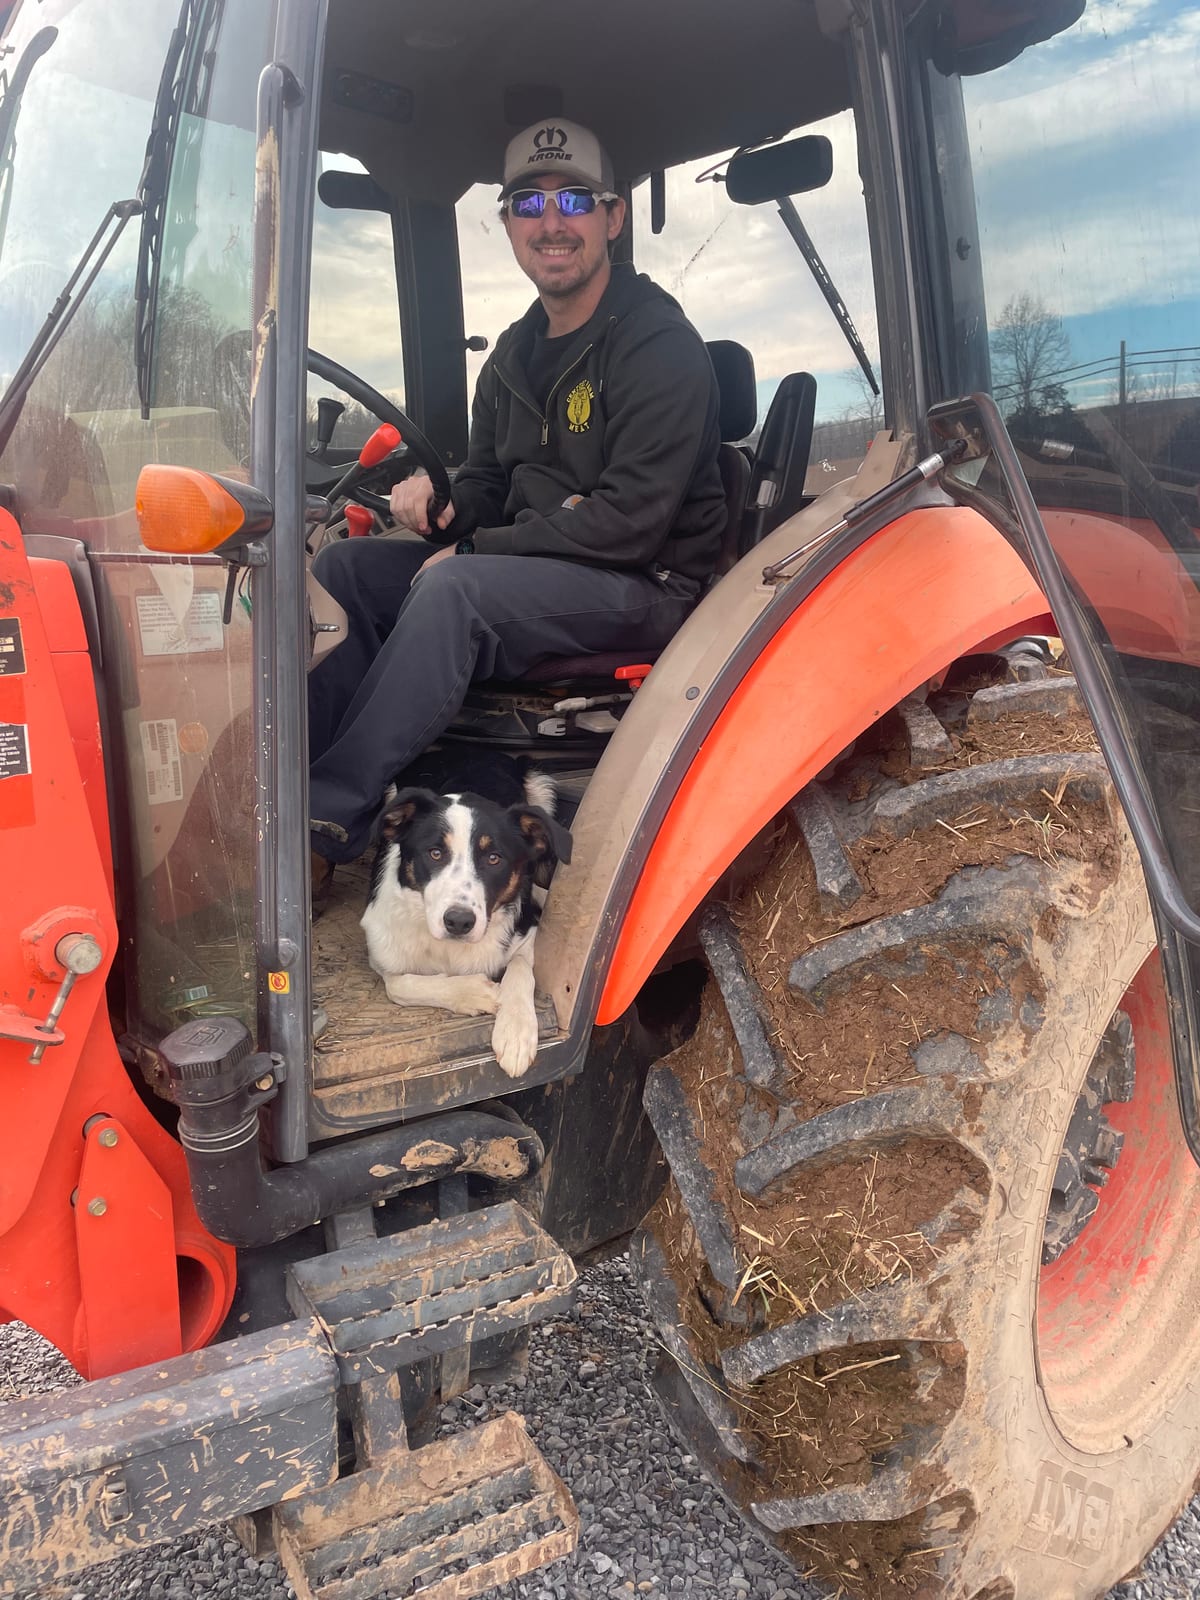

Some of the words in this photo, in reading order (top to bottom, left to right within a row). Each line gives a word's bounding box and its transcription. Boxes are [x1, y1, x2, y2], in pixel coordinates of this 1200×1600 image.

[527, 152, 573, 164] KRONE
[568, 422, 590, 433] MEAT
[1016, 1463, 1113, 1563] BKT
